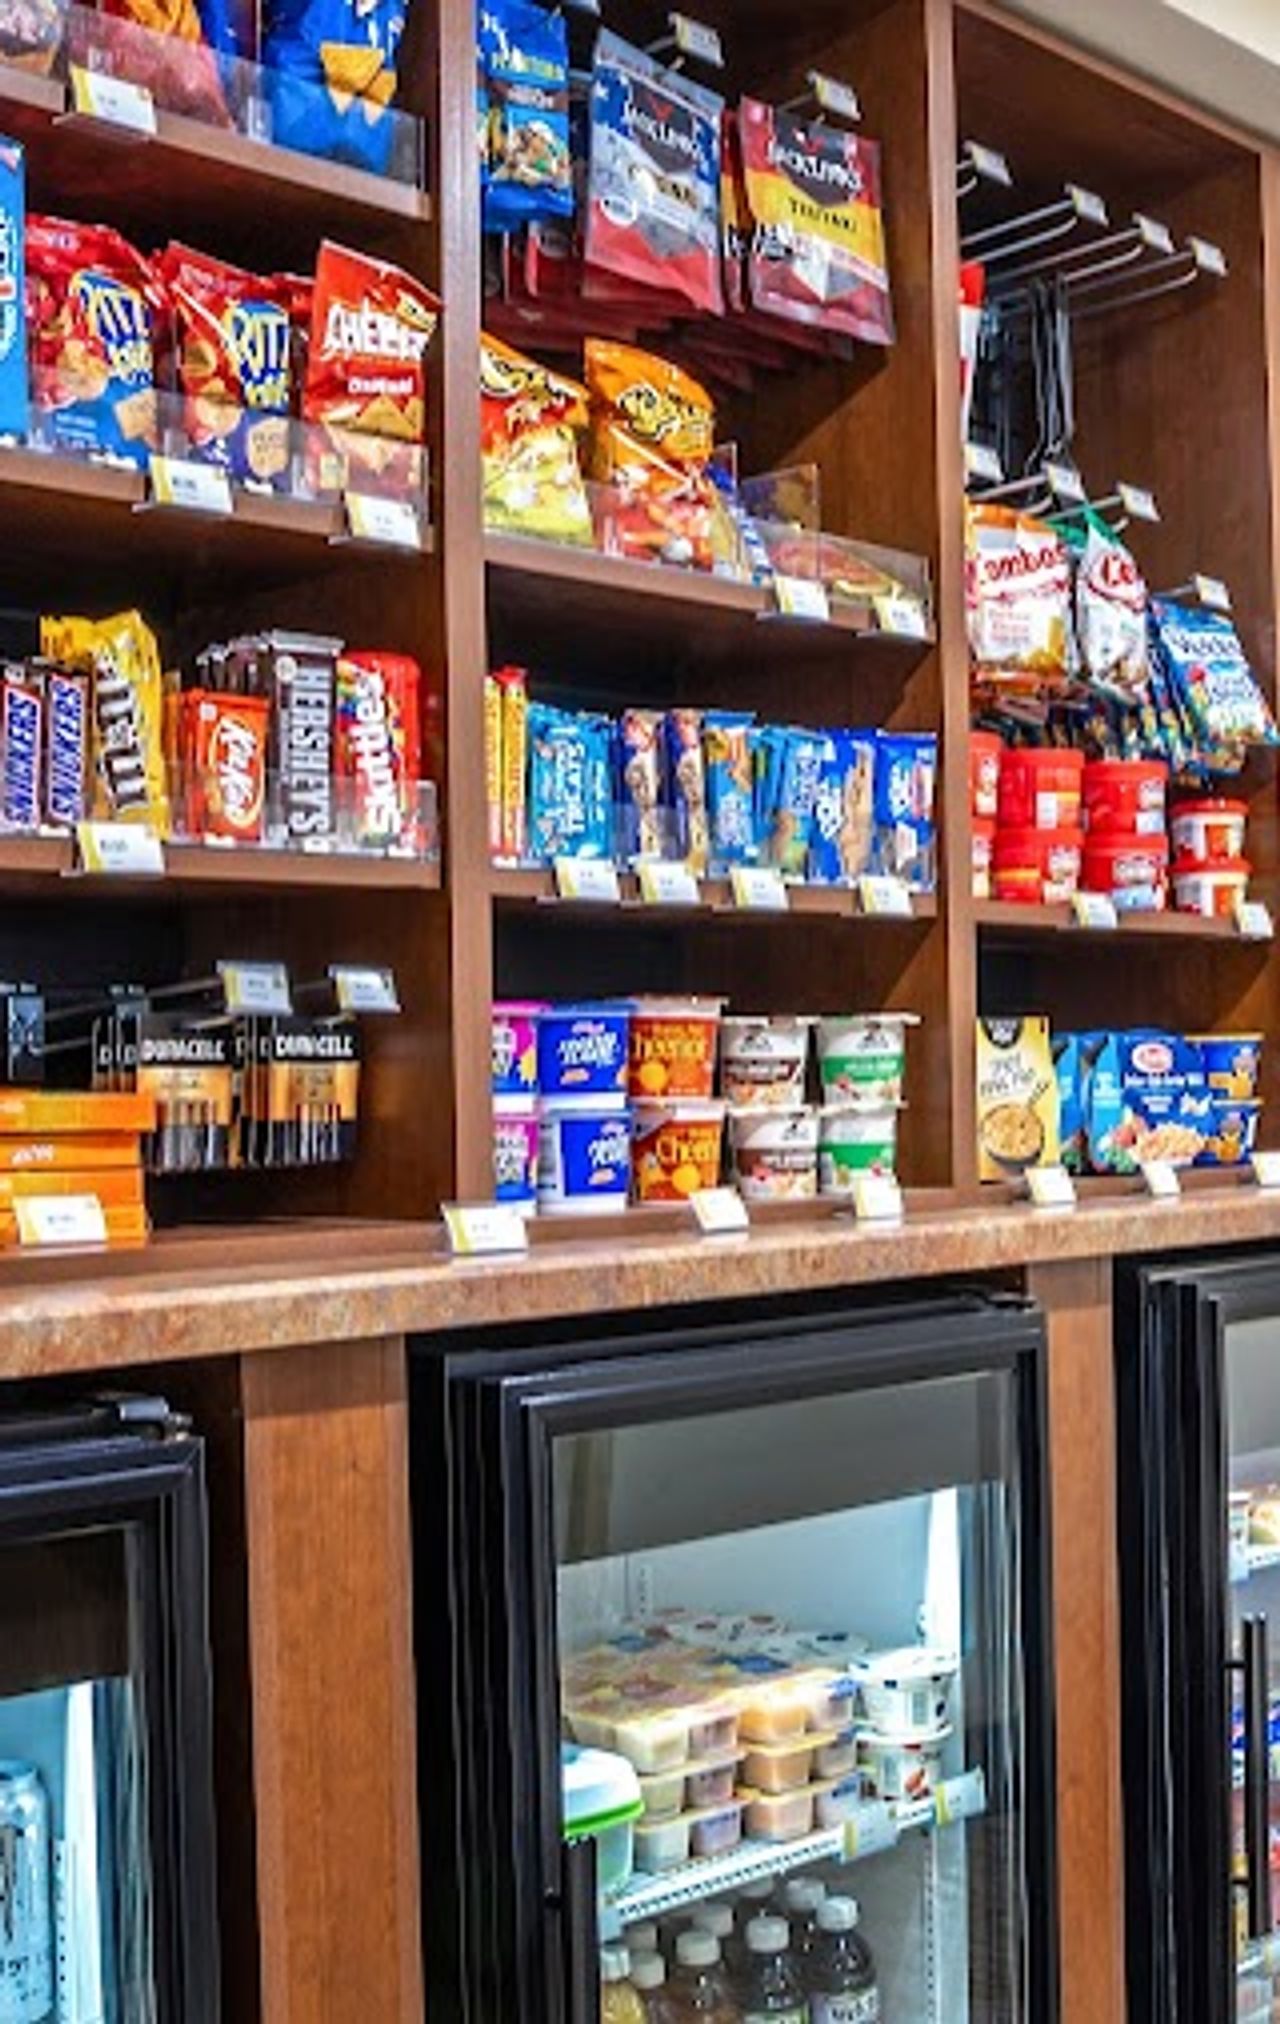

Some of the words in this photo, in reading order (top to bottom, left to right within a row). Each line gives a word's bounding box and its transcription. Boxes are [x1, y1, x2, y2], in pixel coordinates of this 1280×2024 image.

[5, 690, 38, 824] SNICKERS
[51, 680, 83, 824] SNICKERS
[352, 669, 402, 835] Skittles
[142, 1037, 227, 1061] DURACELL
[275, 1034, 354, 1058] DURACELL
